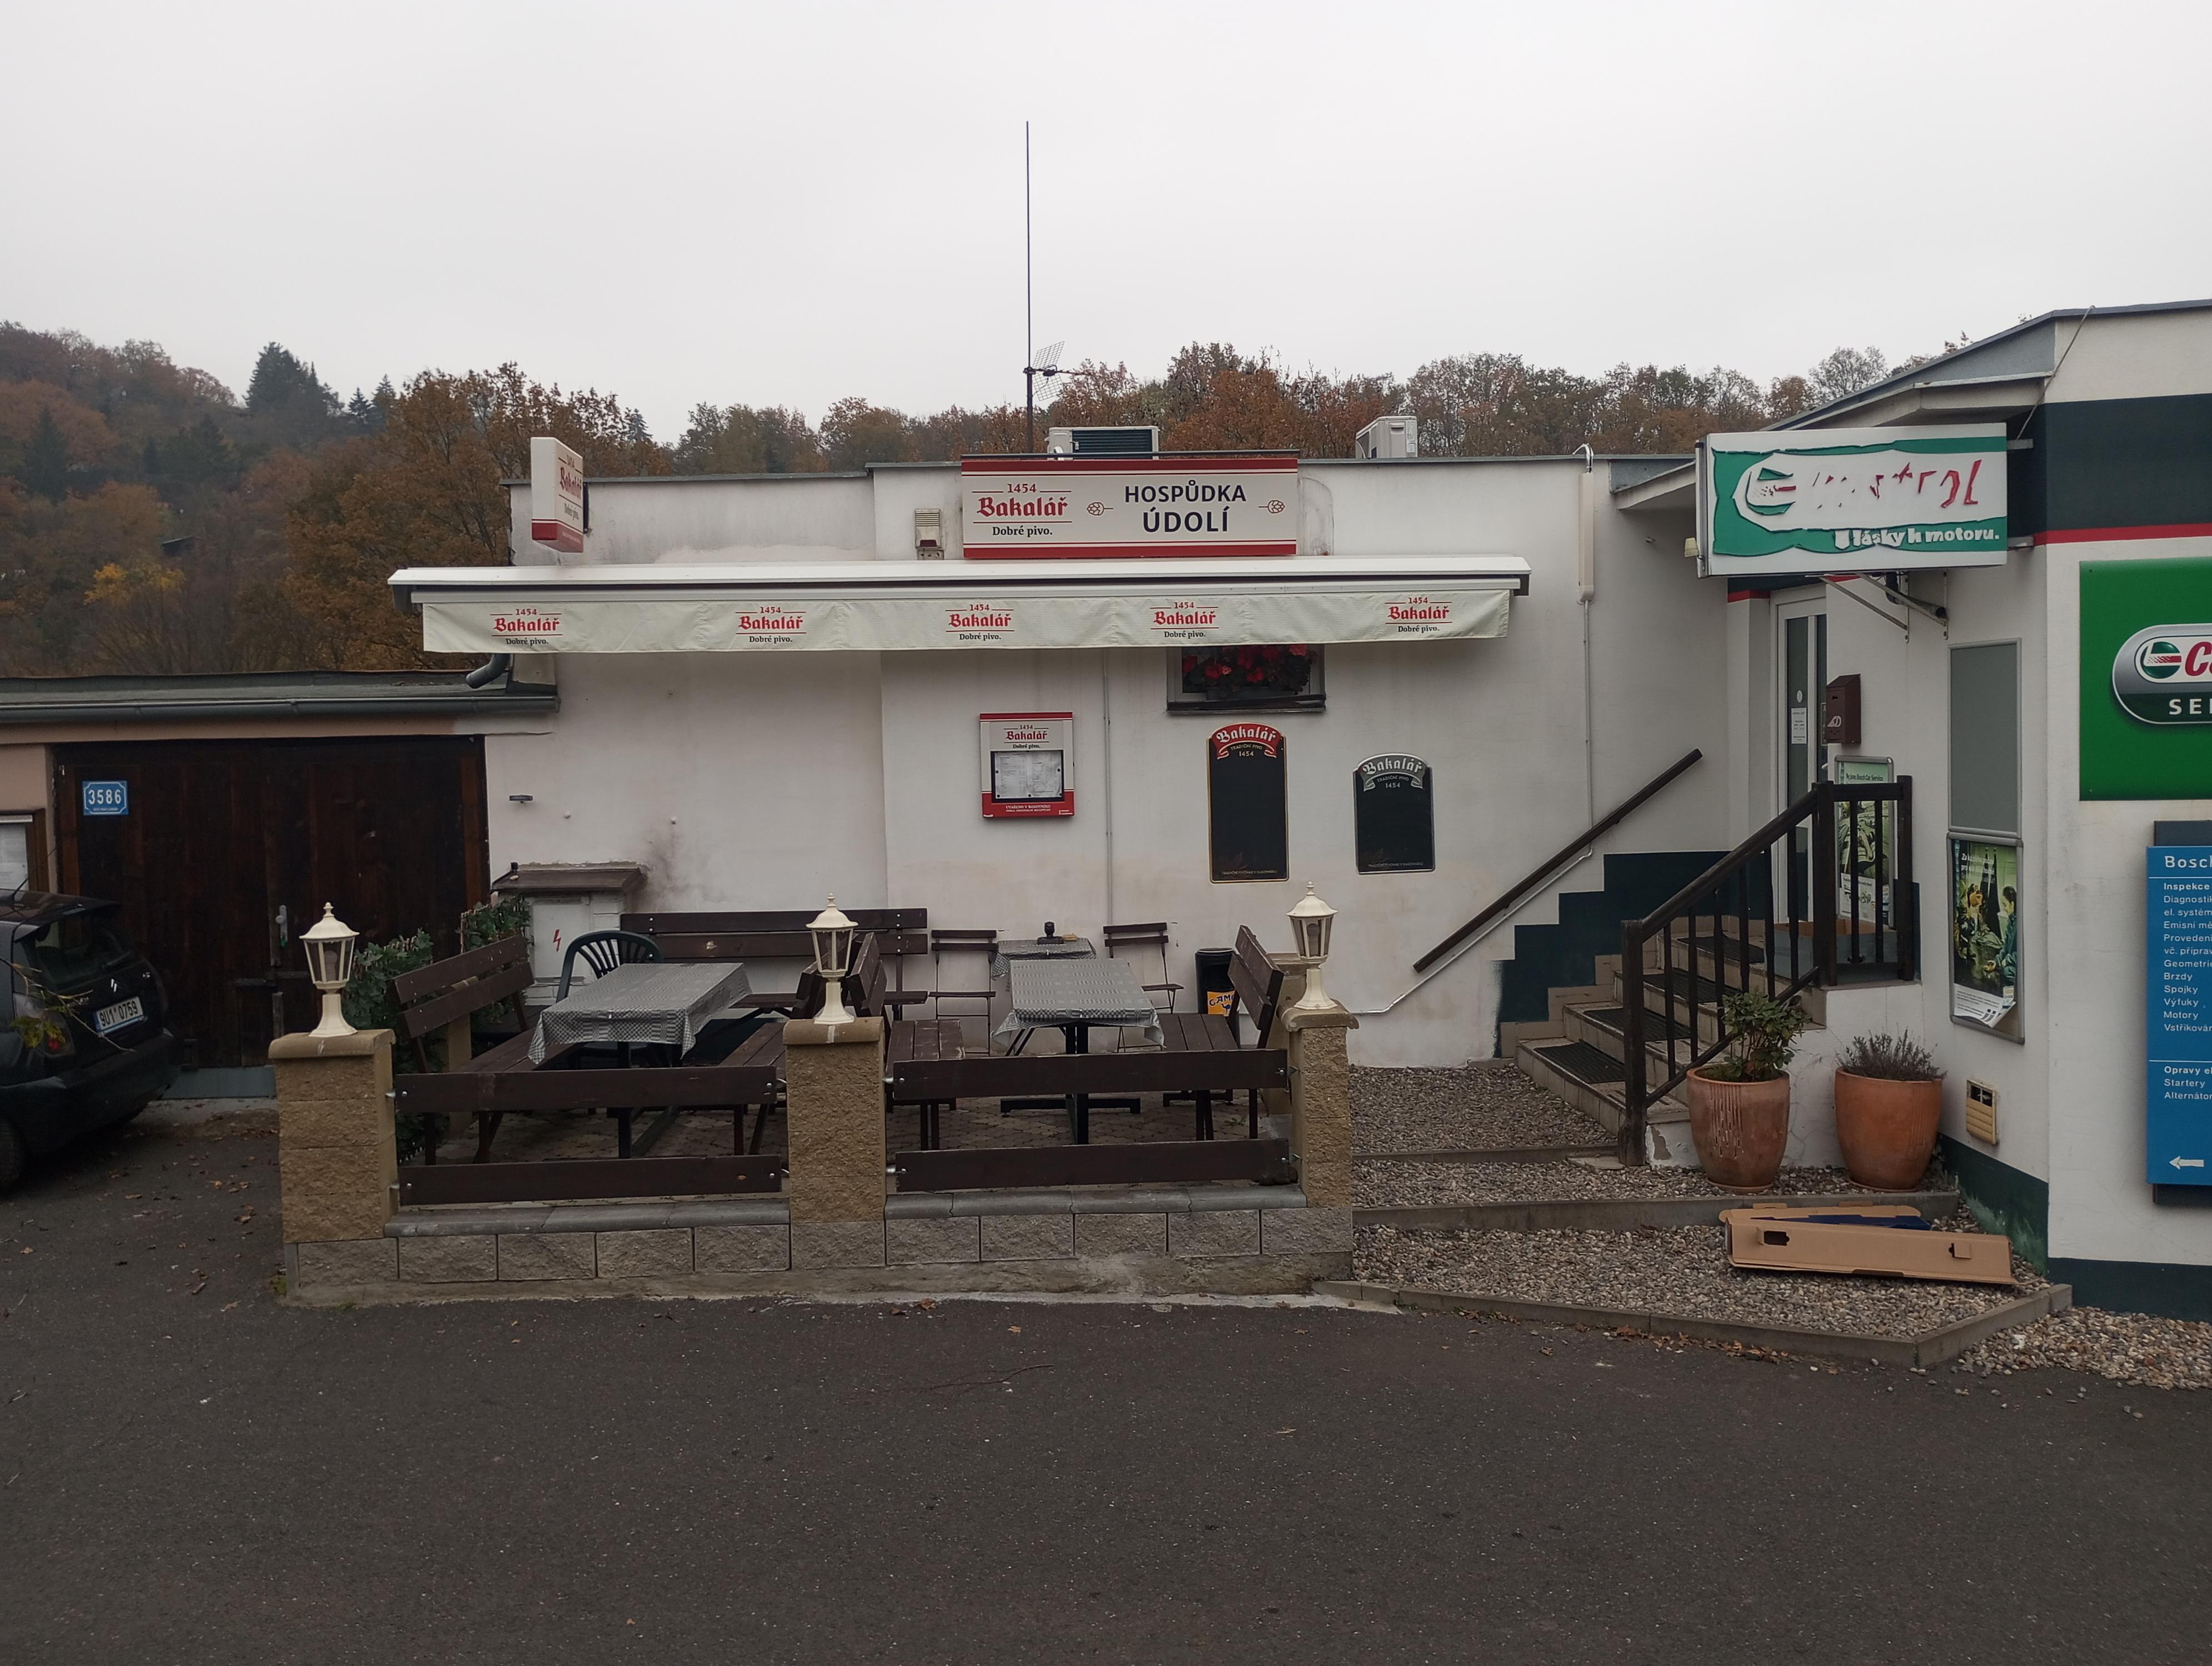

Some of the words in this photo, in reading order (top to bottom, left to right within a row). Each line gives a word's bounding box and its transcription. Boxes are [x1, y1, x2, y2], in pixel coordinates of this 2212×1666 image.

[1007, 483, 1037, 493] 1454
[1124, 480, 1246, 503] HOSPŮDKA
[977, 495, 1068, 518] Bakalář
[1143, 506, 1230, 533] ÚDOLÍ
[992, 524, 1024, 536] Dobré
[1027, 526, 1053, 538] pivo.
[1925, 528, 1999, 543] motoru.
[1153, 610, 1215, 625] Bakalář
[1387, 606, 1450, 620] Bakalář
[493, 617, 560, 633] Bakalář
[738, 615, 803, 630] Bakalář
[948, 613, 1011, 628] Bakalář
[530, 637, 549, 646] pivo.
[773, 635, 793, 644] pivo.
[983, 633, 1002, 642] pivo.
[1188, 631, 1205, 639] pivo.
[2185, 641, 2212, 676] C
[2169, 699, 2212, 715] SE
[1006, 731, 1047, 740] Bakalář
[1216, 726, 1276, 742] Bakalář
[1363, 757, 1422, 775] Bakalář
[88, 789, 121, 805] 3586
[2164, 855, 2212, 868] Bosc
[2164, 883, 2210, 891] Inspekce
[2164, 972, 2193, 981] Brzdy
[2164, 985, 2198, 995] Spojky
[2164, 998, 2198, 1007] Výfuky
[99, 1009, 115, 1027] 9U1
[118, 1001, 138, 1020] 0759
[2164, 1011, 2198, 1020] Motory
[2164, 1066, 2200, 1075] Opravy
[2164, 1078, 2205, 1088] Startery
